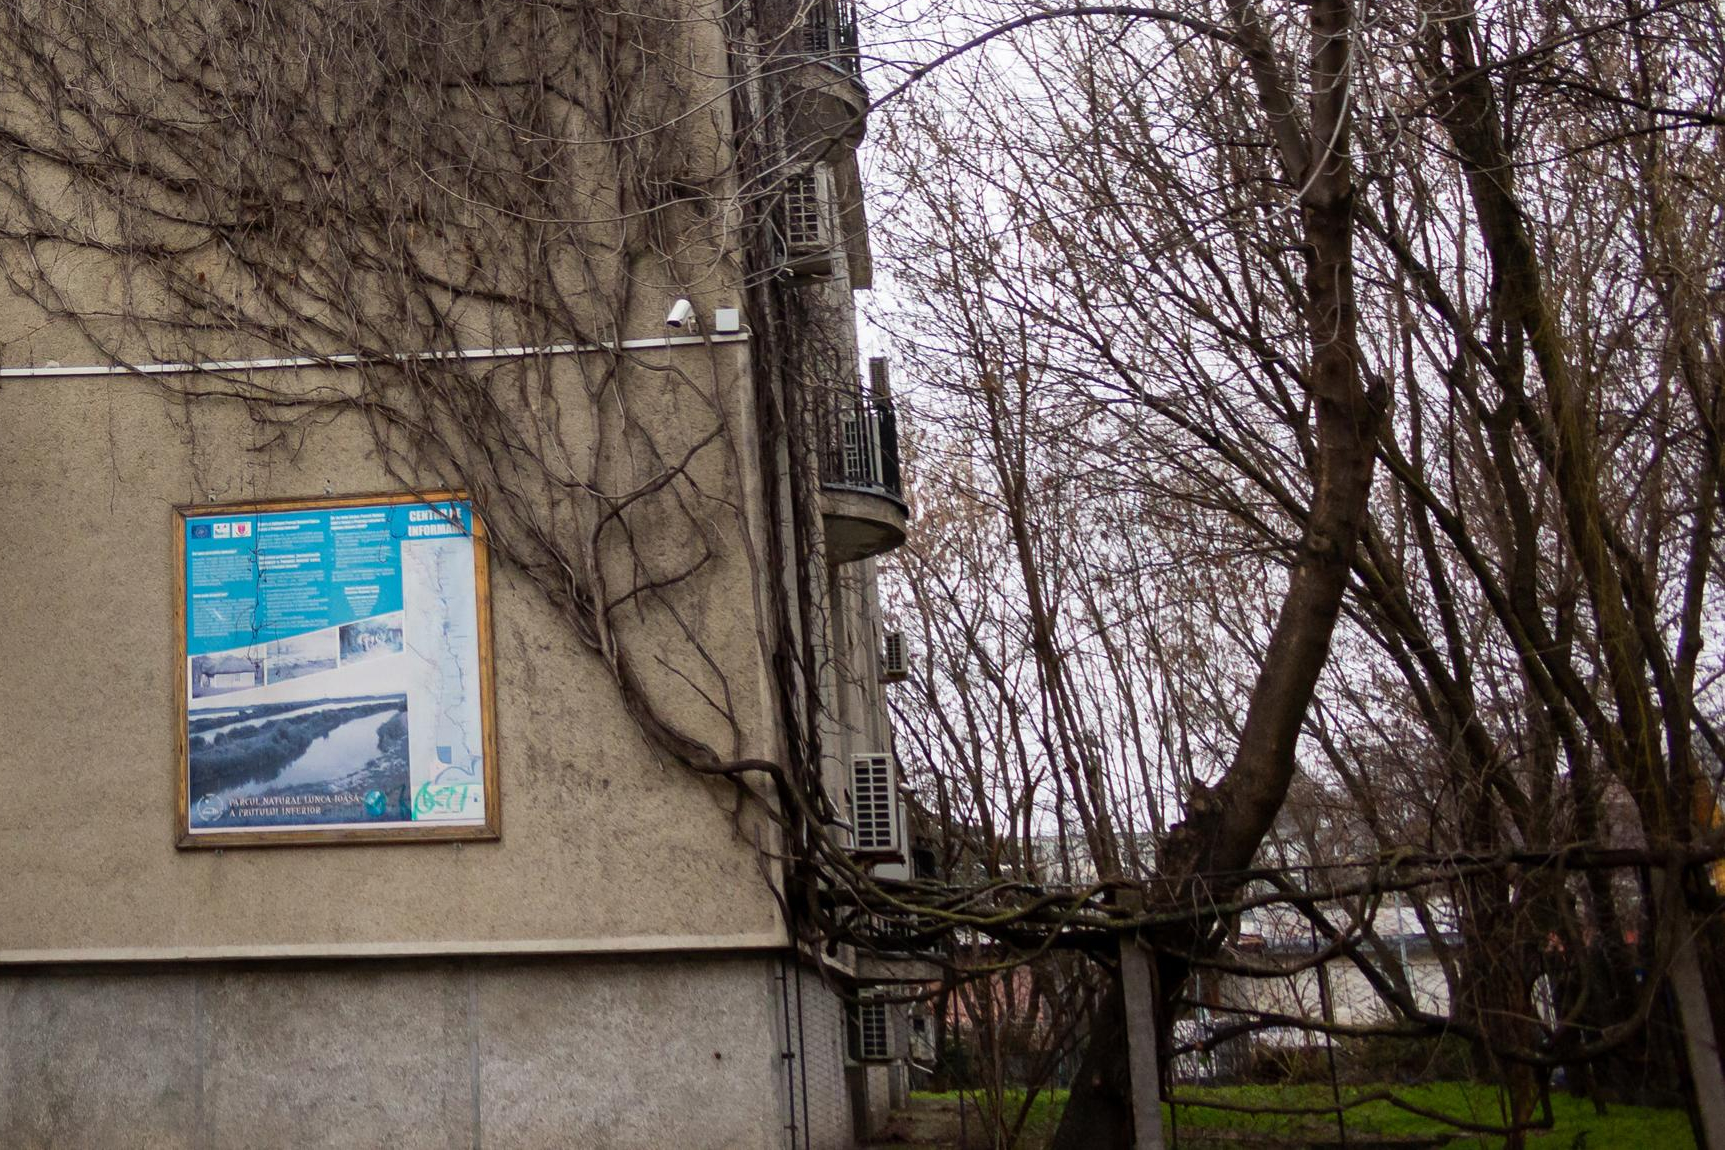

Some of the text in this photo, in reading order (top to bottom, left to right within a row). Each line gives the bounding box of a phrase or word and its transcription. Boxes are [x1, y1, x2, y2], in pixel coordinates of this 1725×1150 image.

[408, 523, 463, 537] INFORMAR
[229, 798, 260, 807] PARCUL
[262, 795, 301, 806] NATURAL
[304, 795, 331, 805] LUNCA
[229, 808, 236, 818] A
[238, 807, 279, 818] PRUTULUI
[281, 805, 322, 816] INFERIOR
